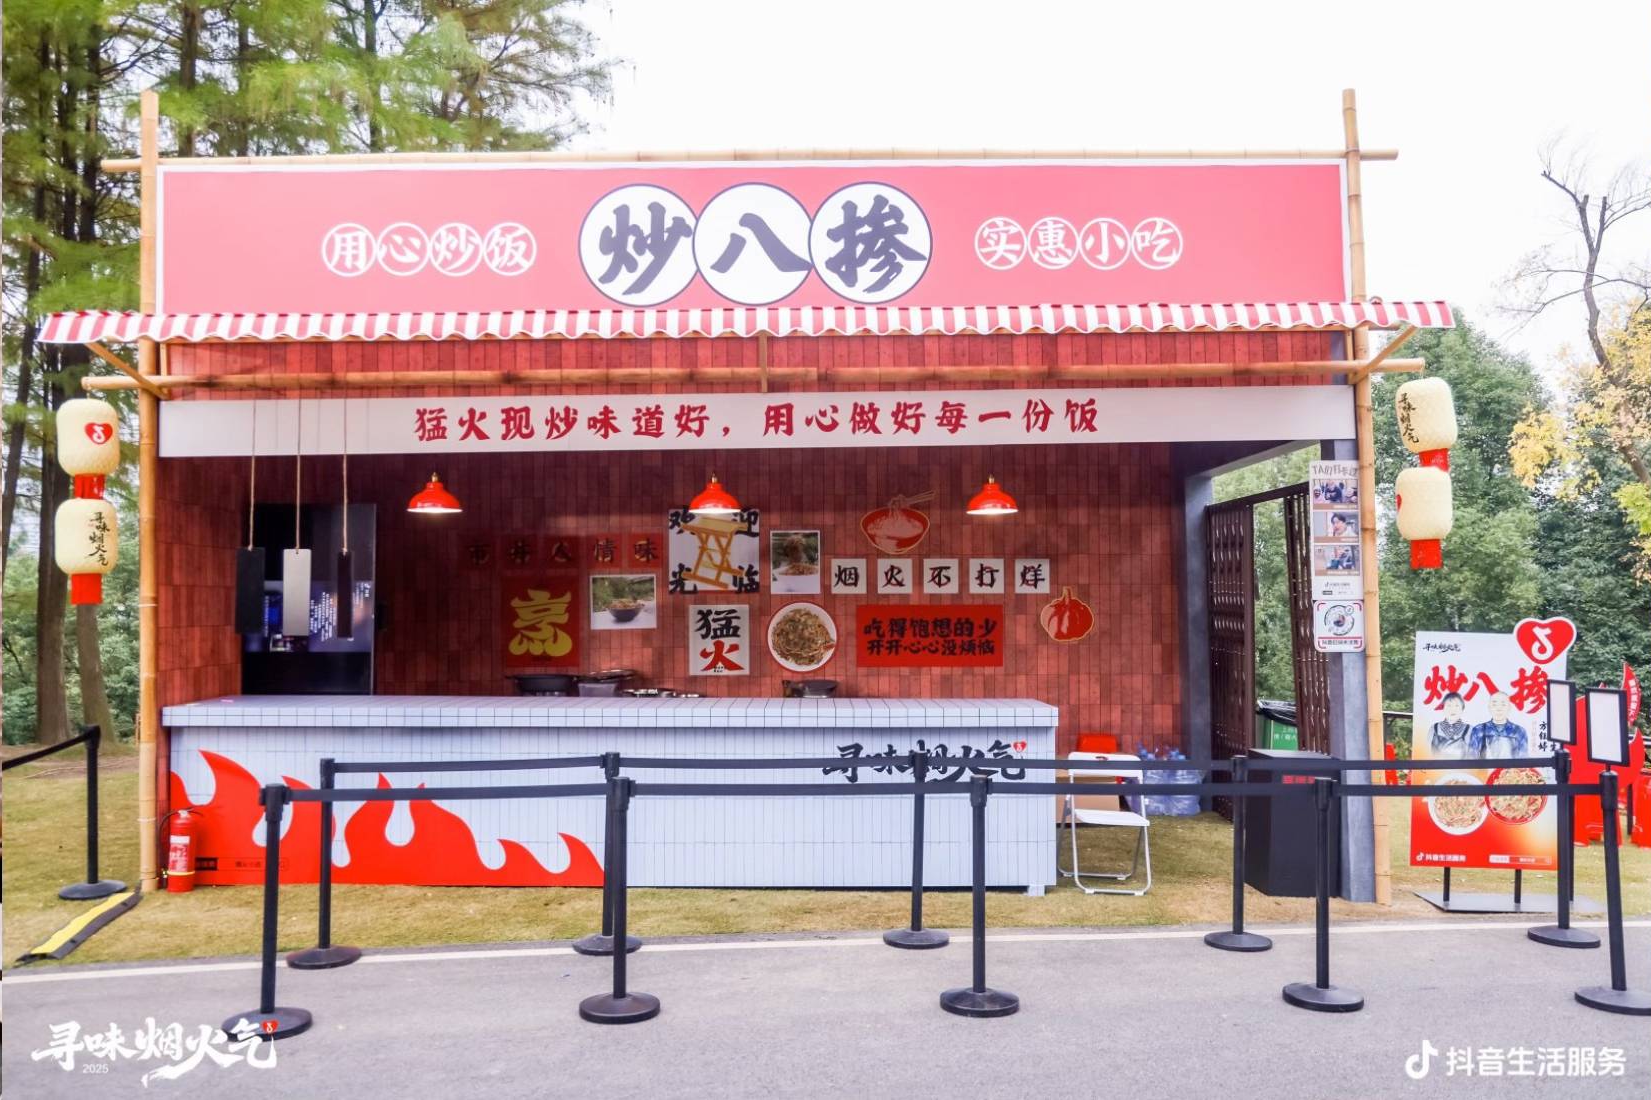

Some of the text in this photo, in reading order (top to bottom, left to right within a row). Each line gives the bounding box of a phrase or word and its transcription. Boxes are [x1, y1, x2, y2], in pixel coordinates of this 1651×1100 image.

[327, 224, 533, 273] 用心炒饭
[598, 194, 928, 295] 炒八掺
[979, 218, 1180, 265] 实惠小吃
[834, 563, 1045, 589] 烟火不打烊
[695, 608, 745, 672] 猛火
